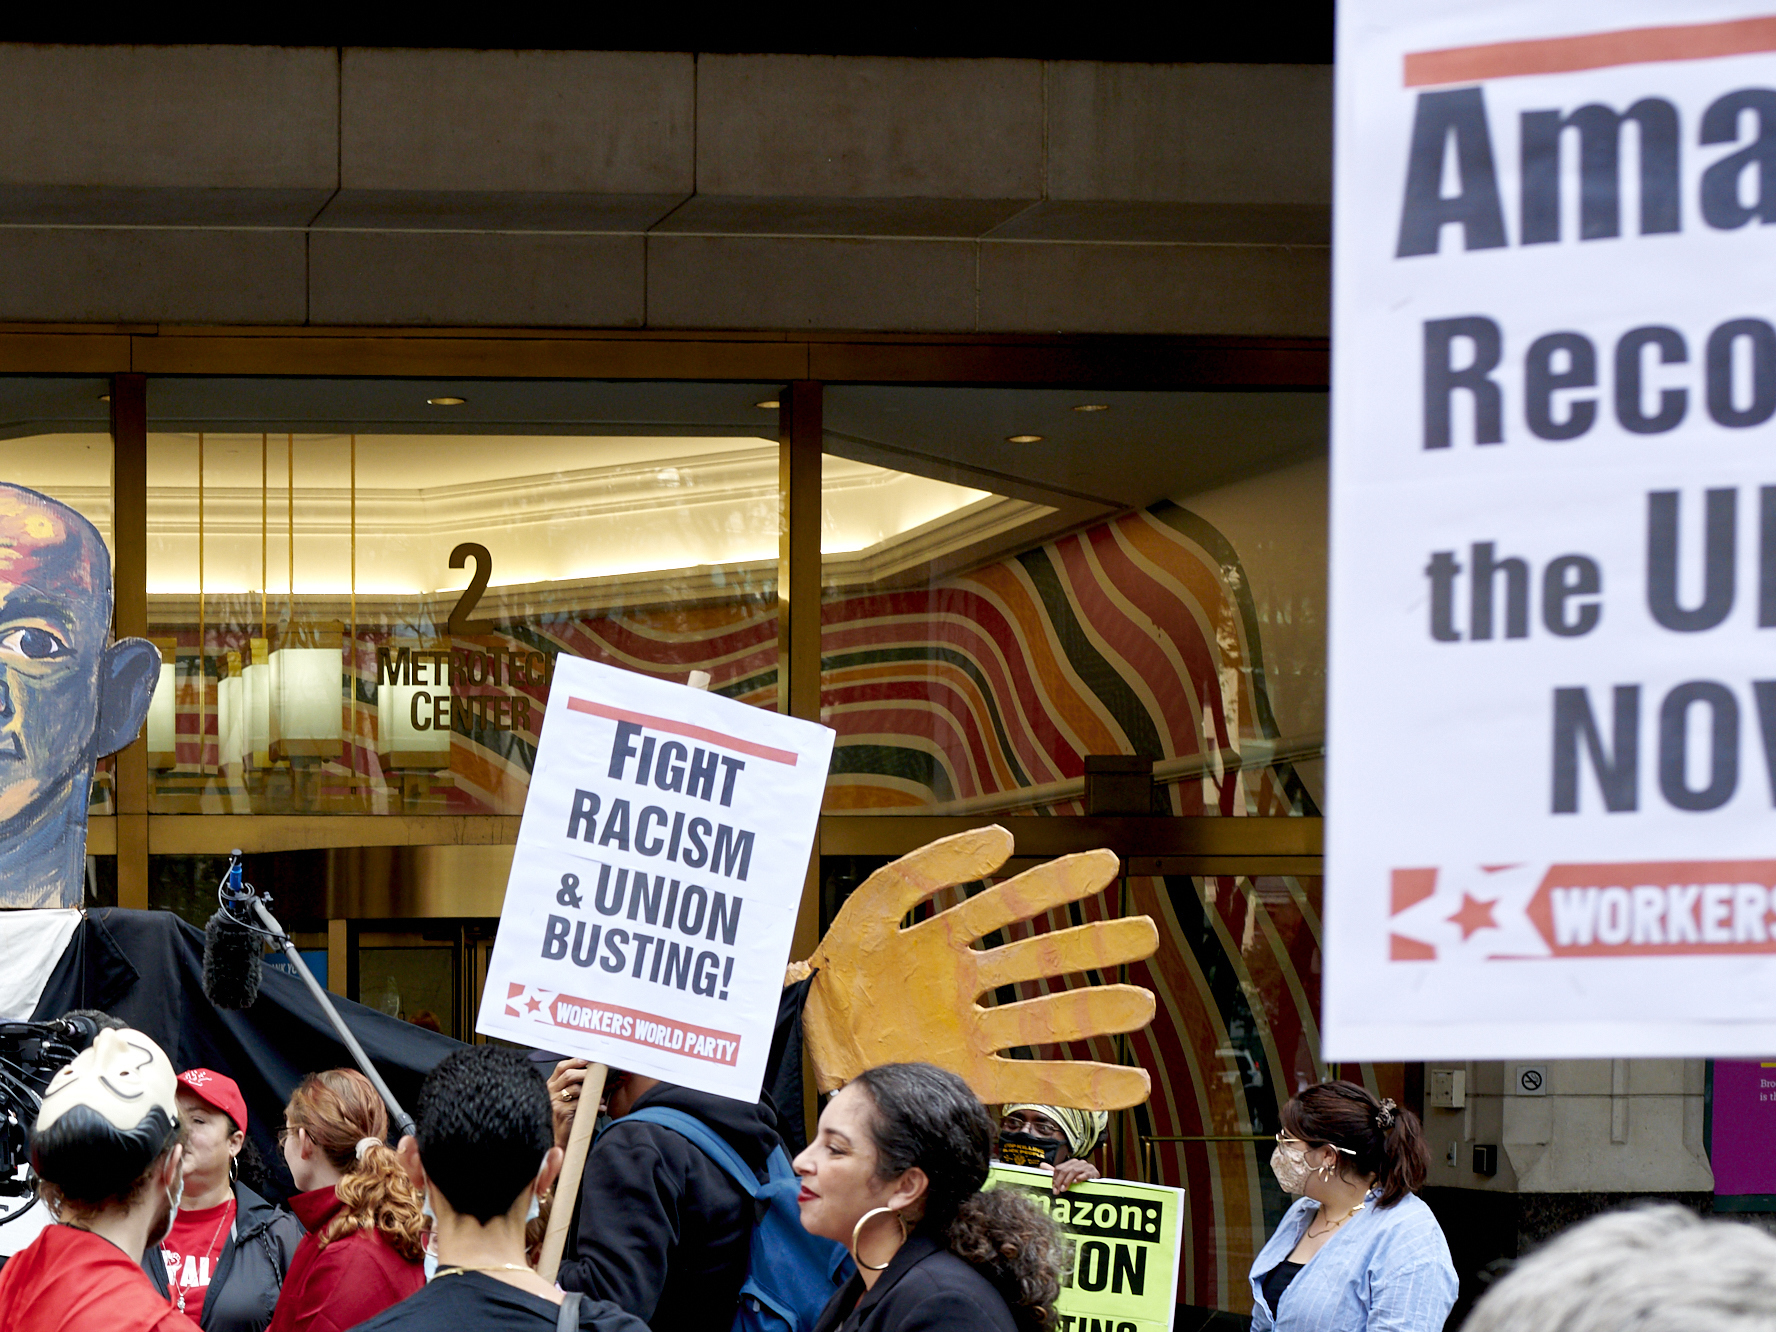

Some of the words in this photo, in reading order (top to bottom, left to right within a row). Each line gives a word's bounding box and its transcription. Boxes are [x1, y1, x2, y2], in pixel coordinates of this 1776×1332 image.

[448, 542, 494, 635] 2
[1423, 540, 1603, 643] the
[1645, 484, 1776, 633] U
[411, 691, 531, 731] CENTER
[607, 719, 746, 808] FIGHT
[566, 788, 756, 882] RACISM
[555, 872, 583, 910] &
[594, 863, 743, 946] UNION
[540, 913, 736, 1001] BUSTING!
[556, 1001, 634, 1037] WORKERS
[634, 1018, 684, 1051] WORLD
[683, 1036, 737, 1062] PARTY
